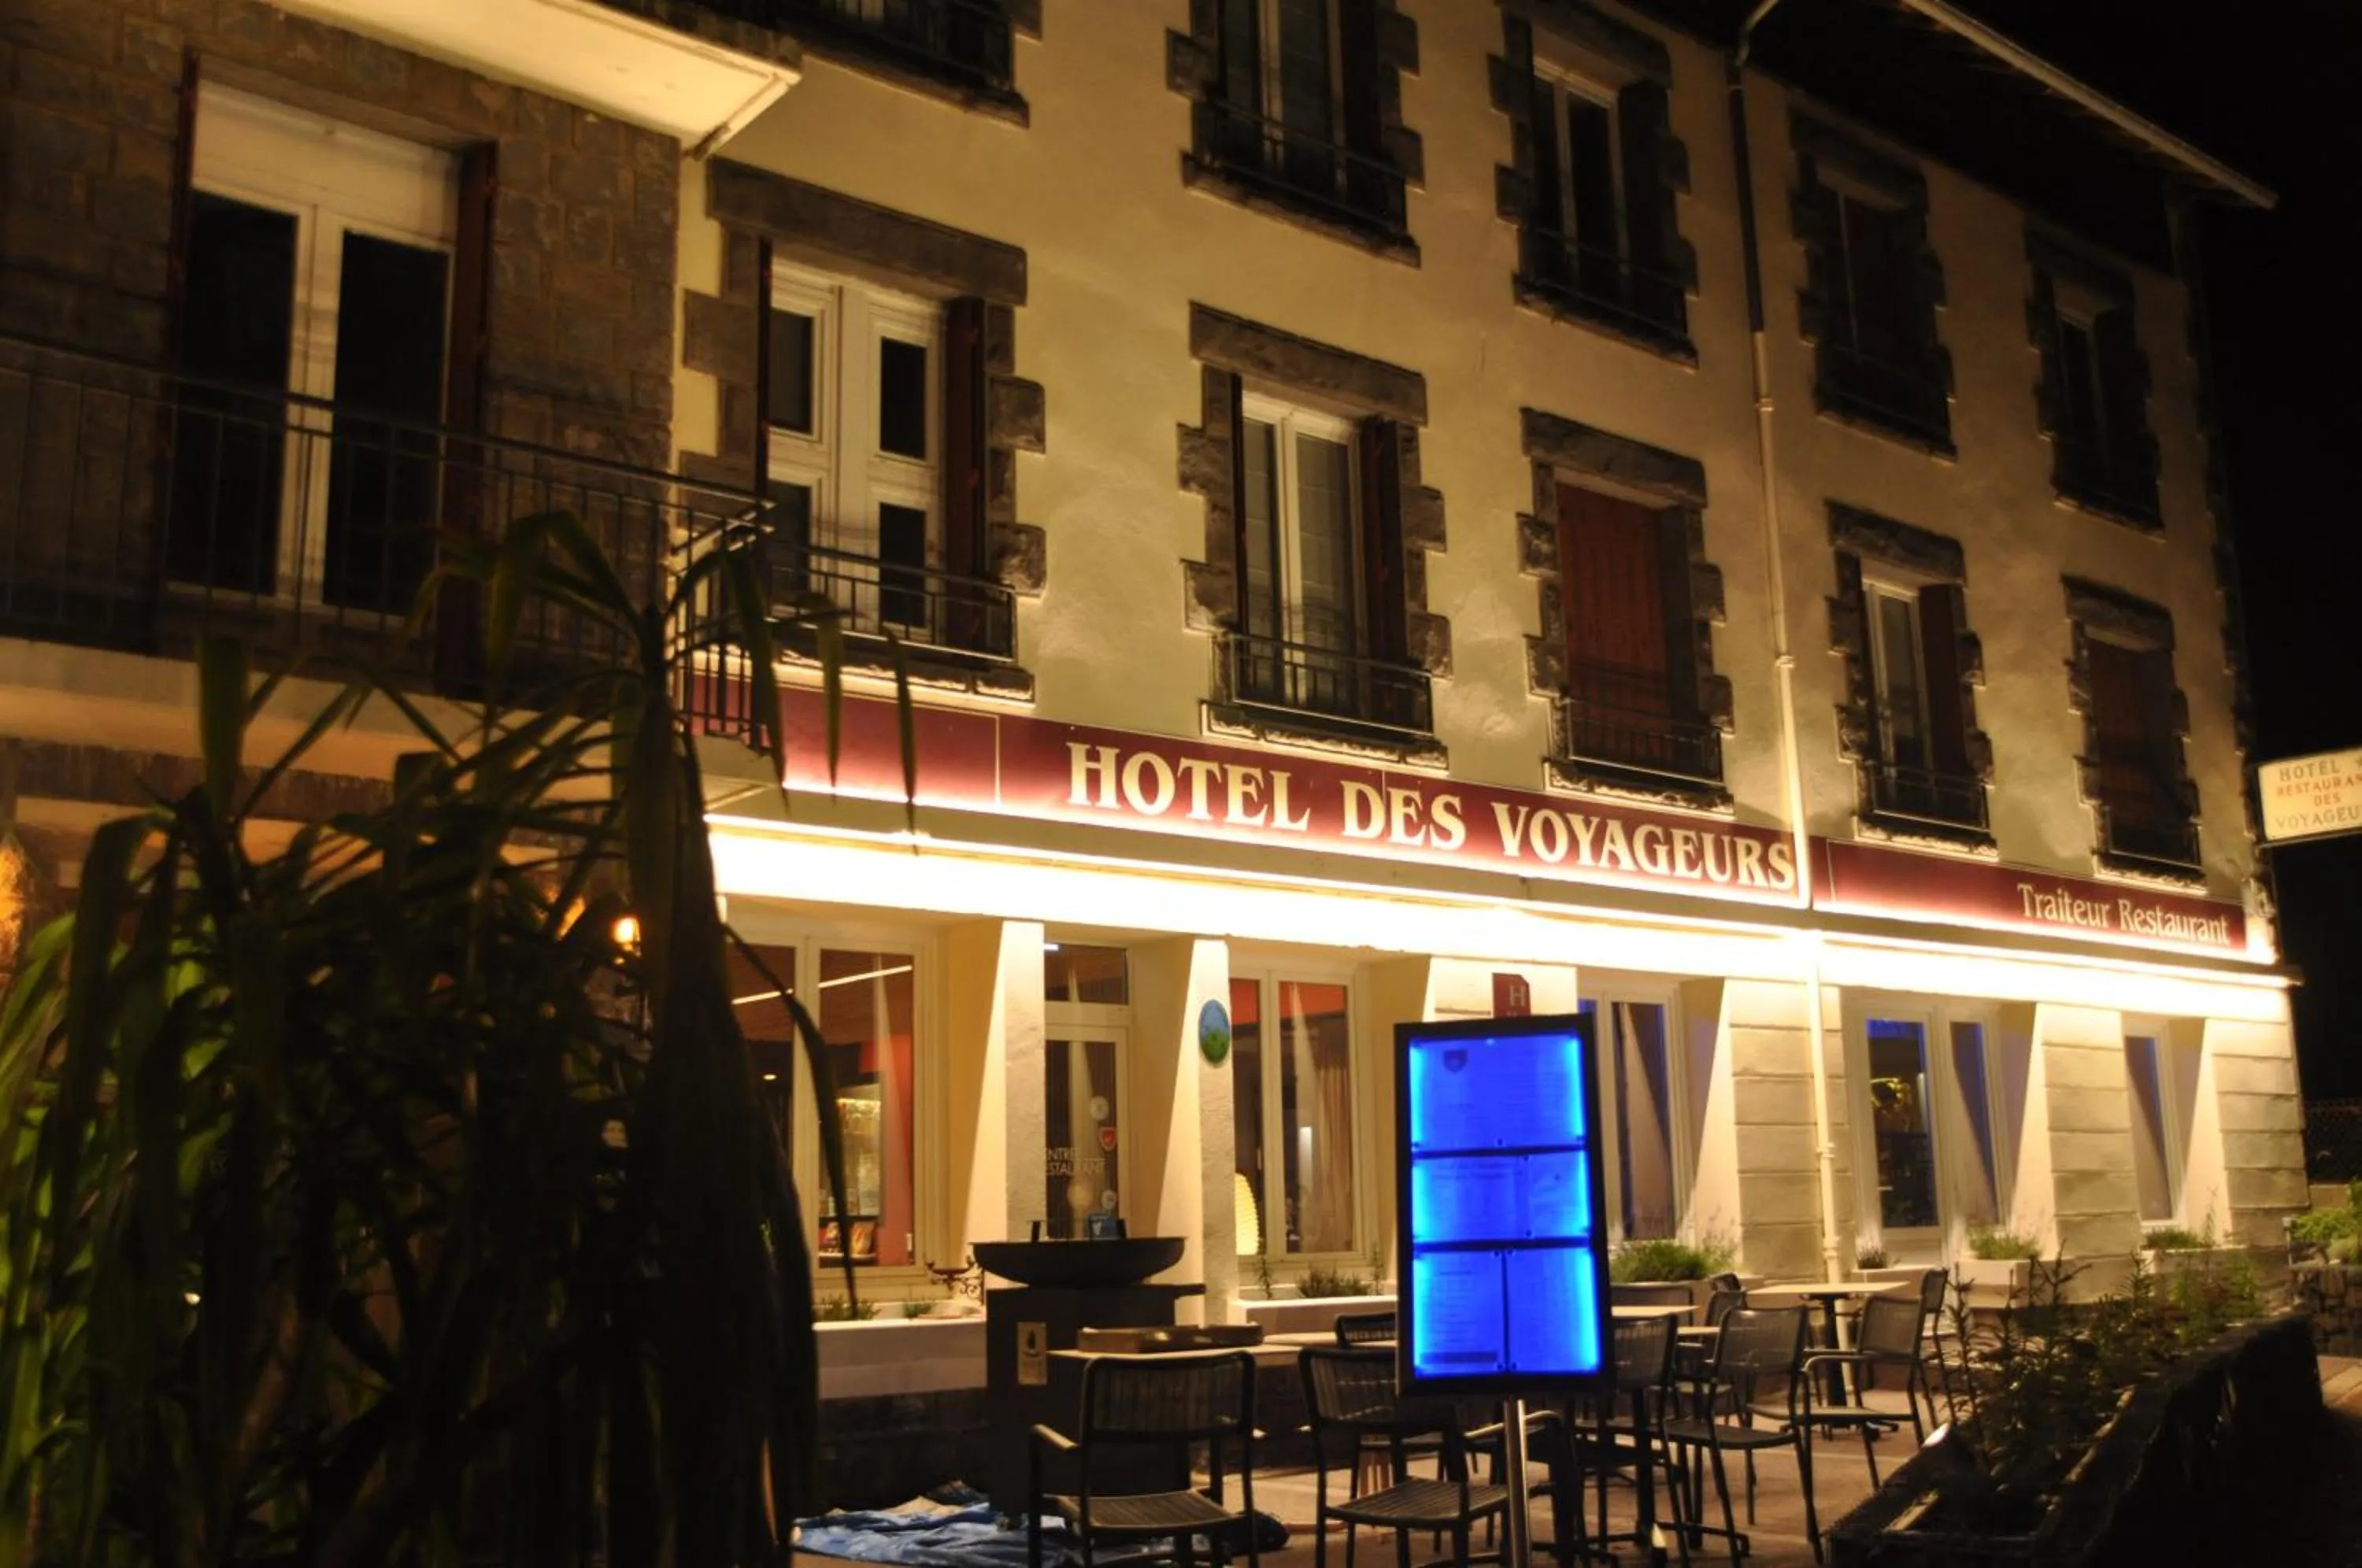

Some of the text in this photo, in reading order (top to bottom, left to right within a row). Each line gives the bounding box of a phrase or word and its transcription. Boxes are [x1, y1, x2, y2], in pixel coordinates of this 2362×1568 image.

[2279, 759, 2341, 782] HOTEL
[2313, 792, 2342, 807] DES
[1067, 743, 1795, 890] HOTEL DES VOYAGEURS
[2017, 884, 2229, 945] Traiteur Restaurant
[1509, 984, 1526, 1007] H
